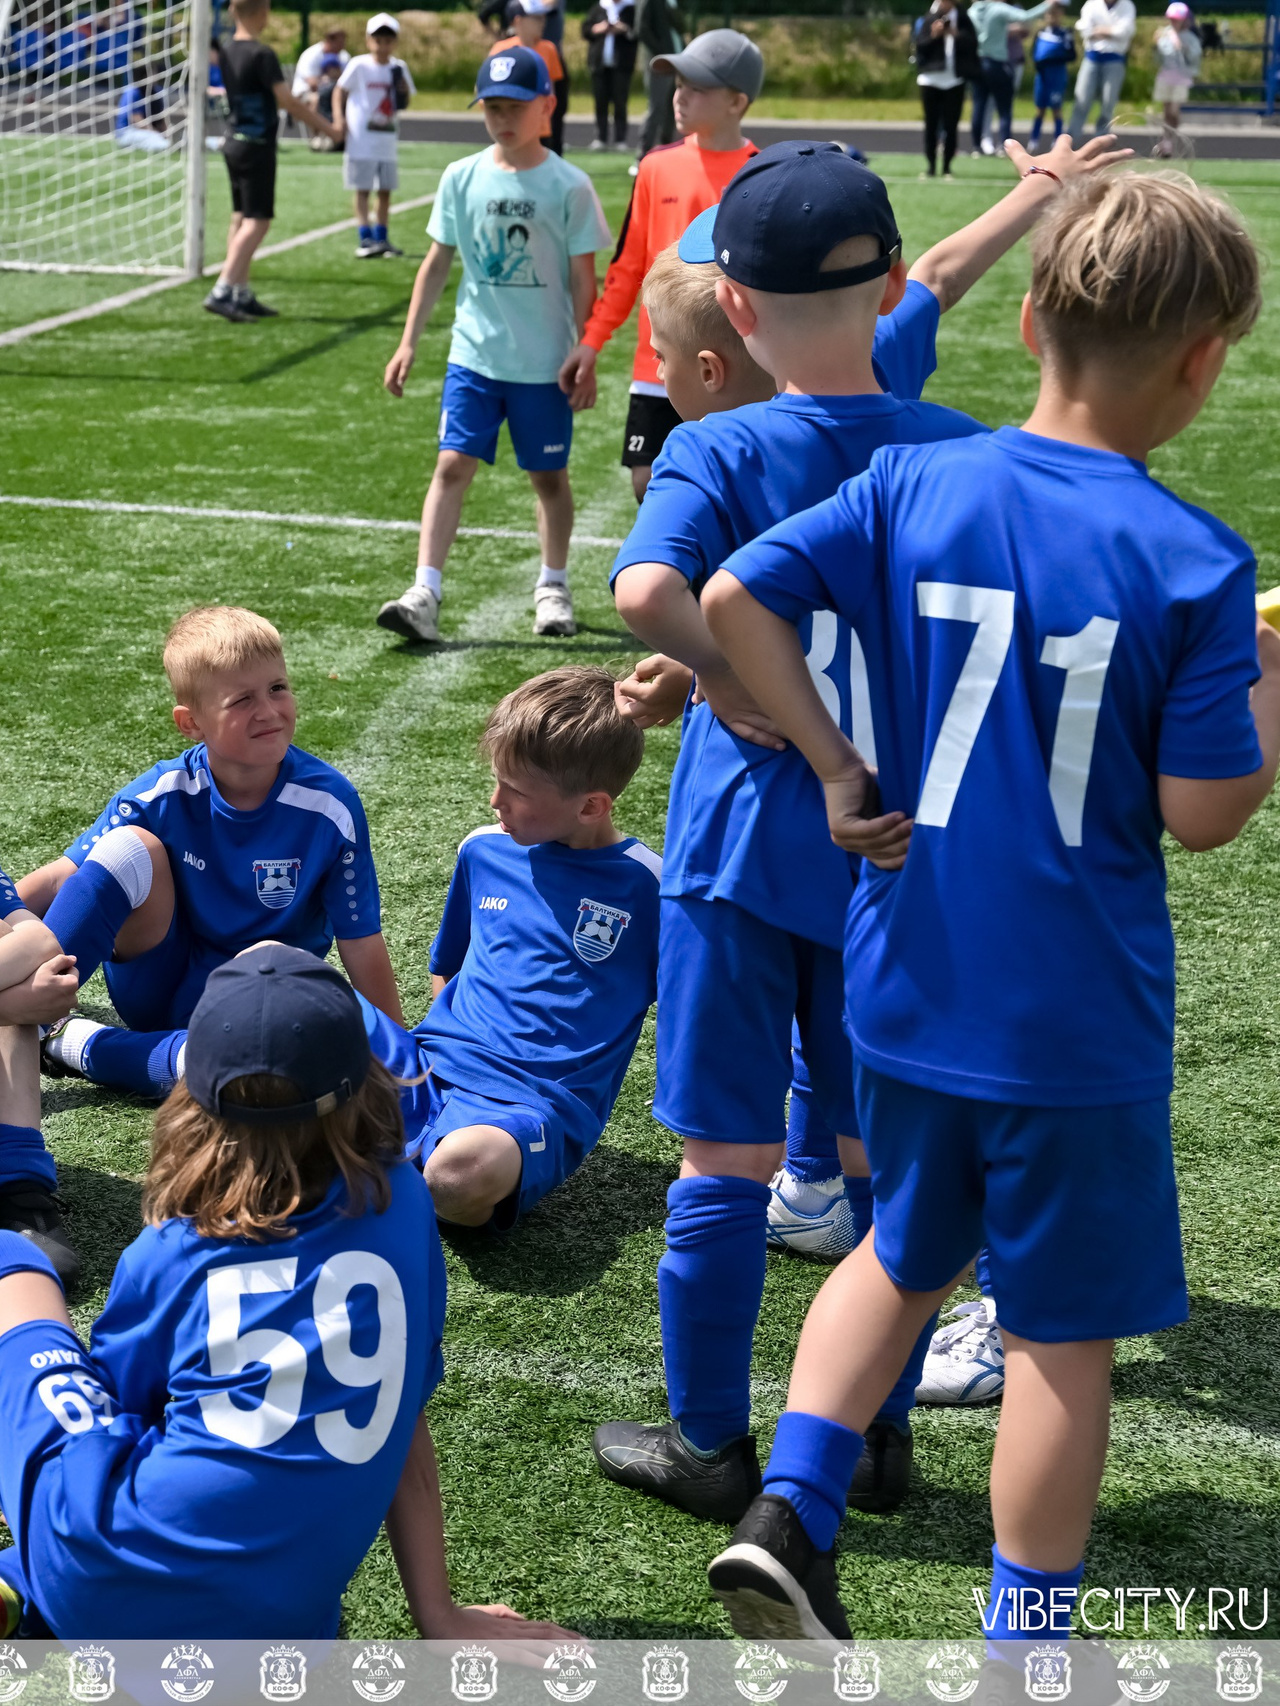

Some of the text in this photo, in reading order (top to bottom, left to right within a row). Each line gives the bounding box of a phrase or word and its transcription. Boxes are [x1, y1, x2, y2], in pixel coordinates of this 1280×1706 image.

[628, 435, 645, 452] 27
[914, 581, 1120, 847] 71
[478, 896, 509, 911] JAKO
[589, 904, 621, 919] БАЛТИКА
[29, 1349, 81, 1369] JAKO
[198, 1250, 408, 1465] 59
